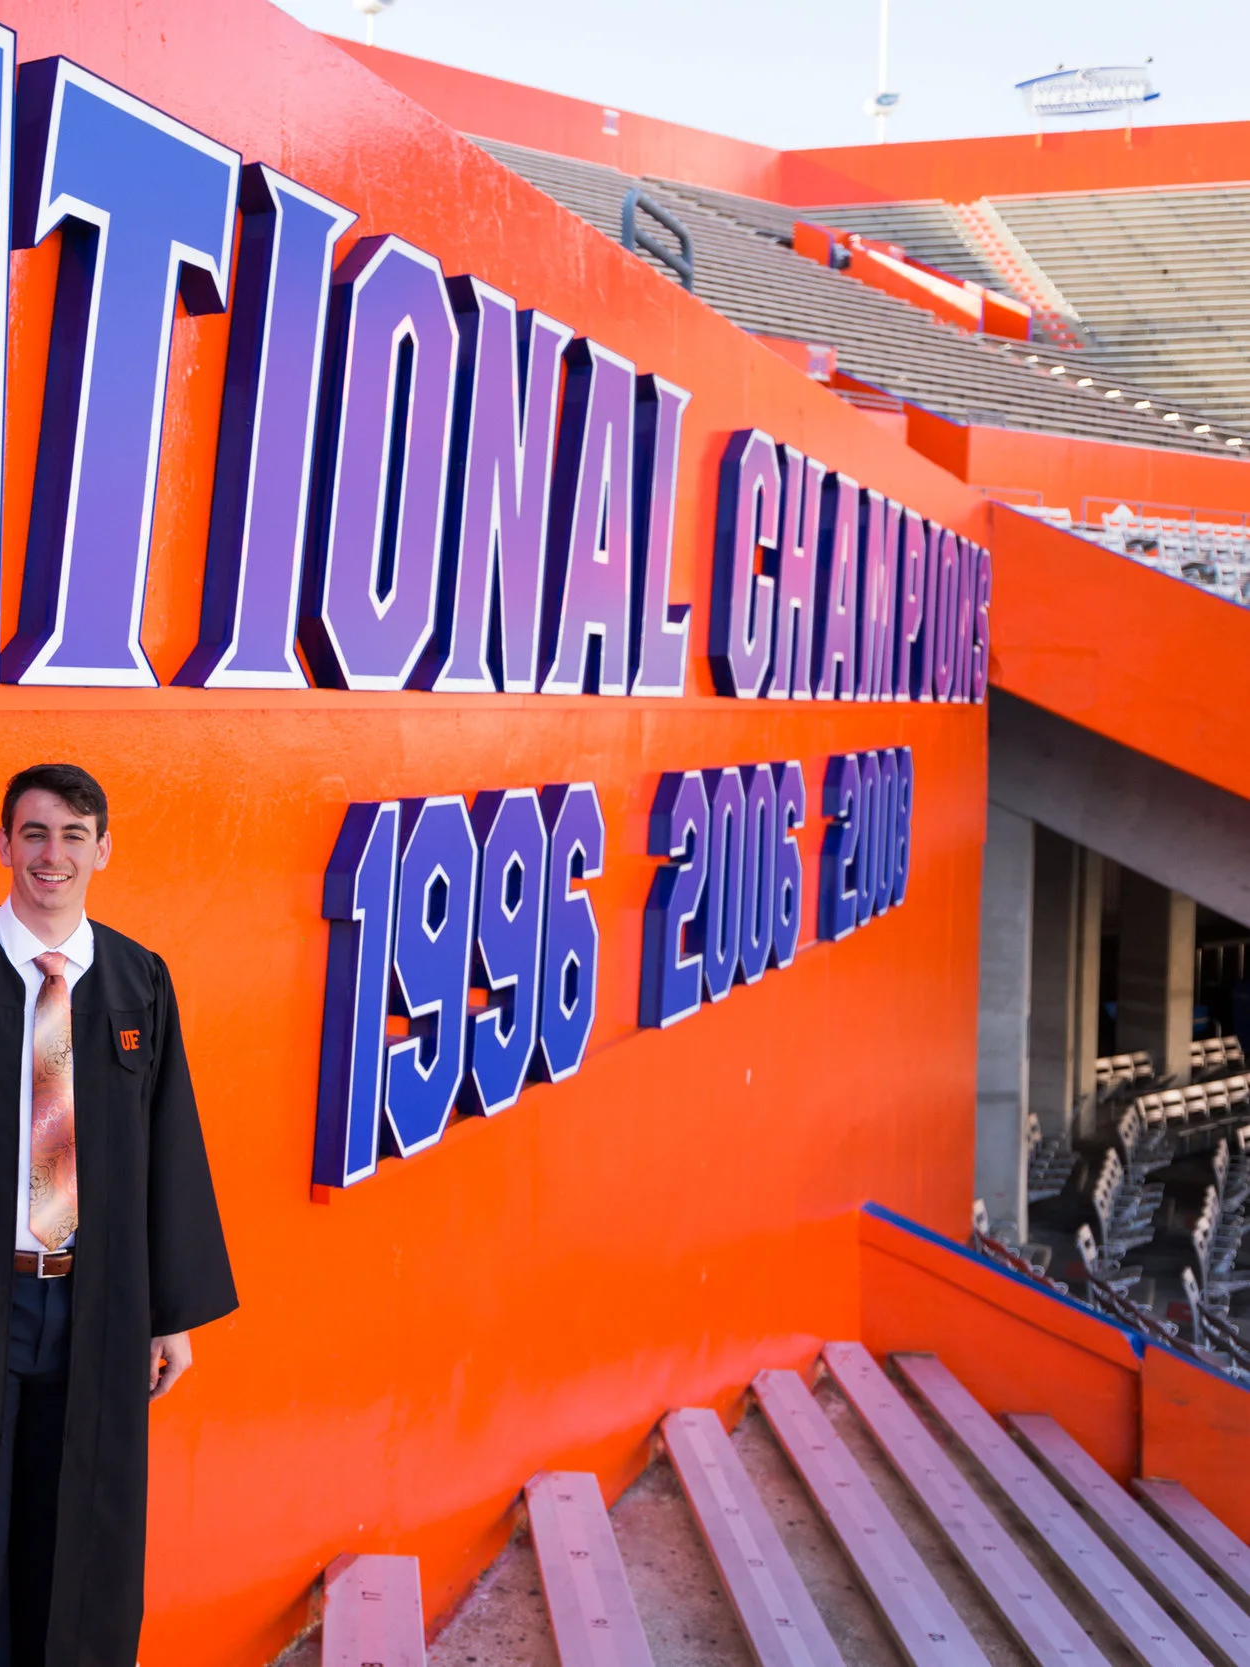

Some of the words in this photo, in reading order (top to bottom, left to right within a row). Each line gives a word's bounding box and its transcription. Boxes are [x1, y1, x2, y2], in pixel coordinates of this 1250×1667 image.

[725, 428, 992, 704] CHAMPIONS
[119, 1029, 141, 1051] UF
[330, 781, 605, 1188] 1996
[650, 760, 806, 1029] 2006
[828, 746, 914, 943] 2008
